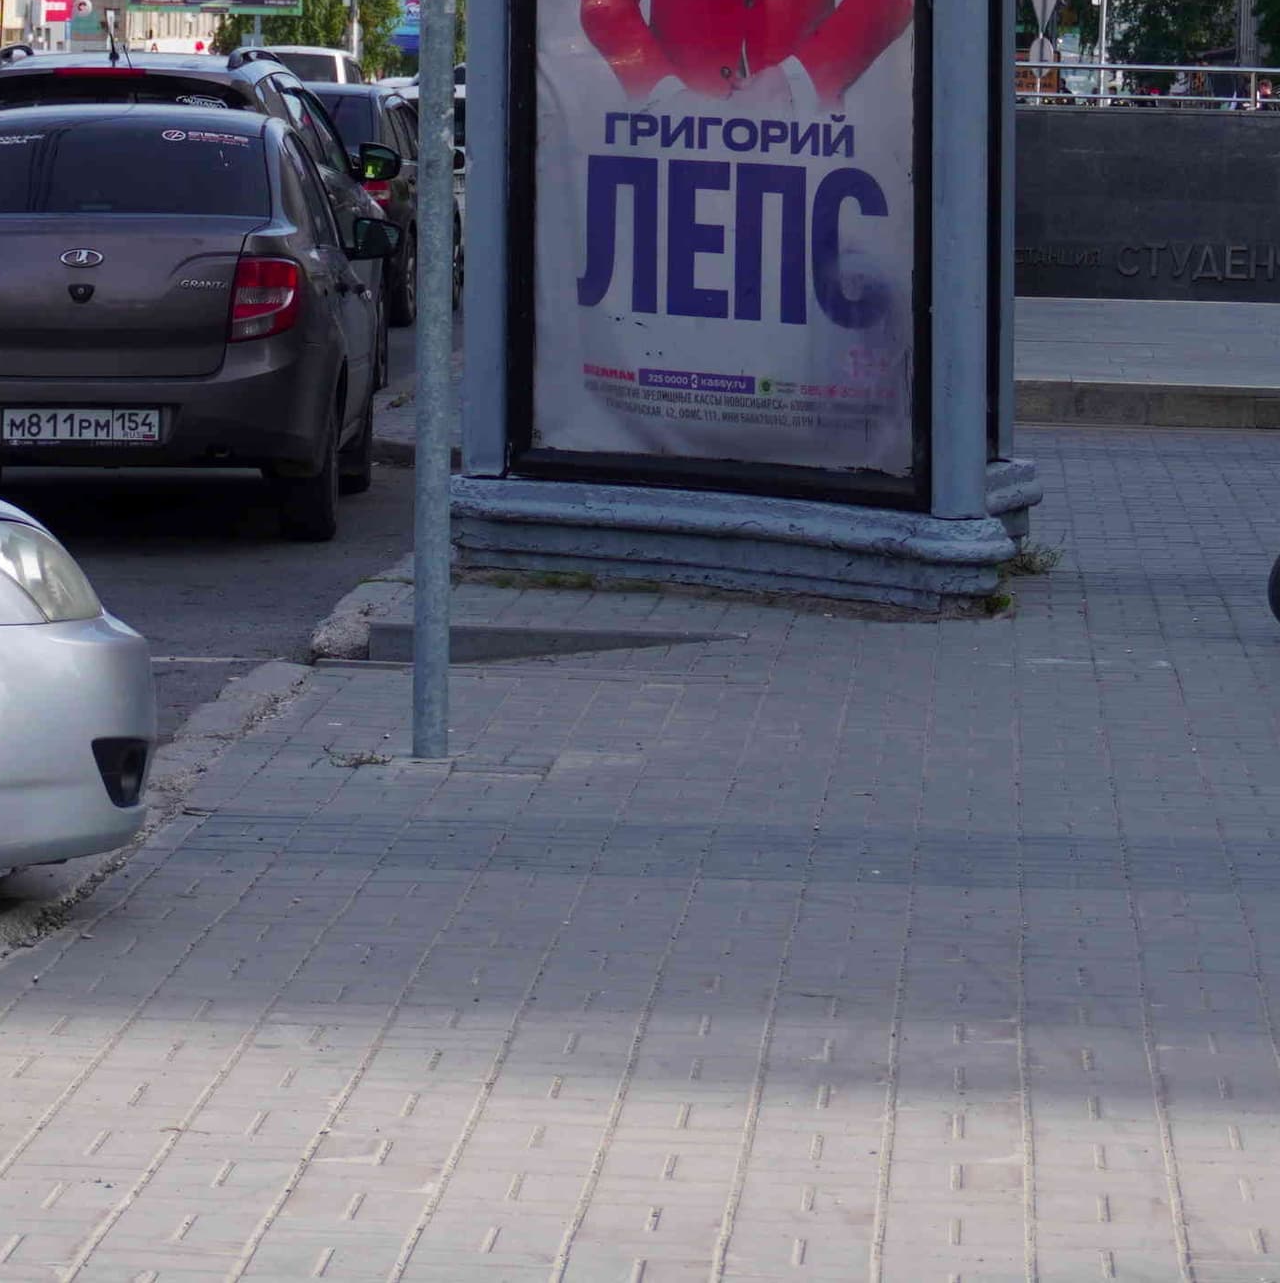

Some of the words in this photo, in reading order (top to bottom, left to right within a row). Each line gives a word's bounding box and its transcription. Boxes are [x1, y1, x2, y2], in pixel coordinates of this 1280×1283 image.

[604, 111, 855, 158] ГРИГОРИЙ
[577, 154, 892, 329] ЛЕПС
[701, 377, 747, 391] kassy.ru
[115, 412, 154, 432] 154
